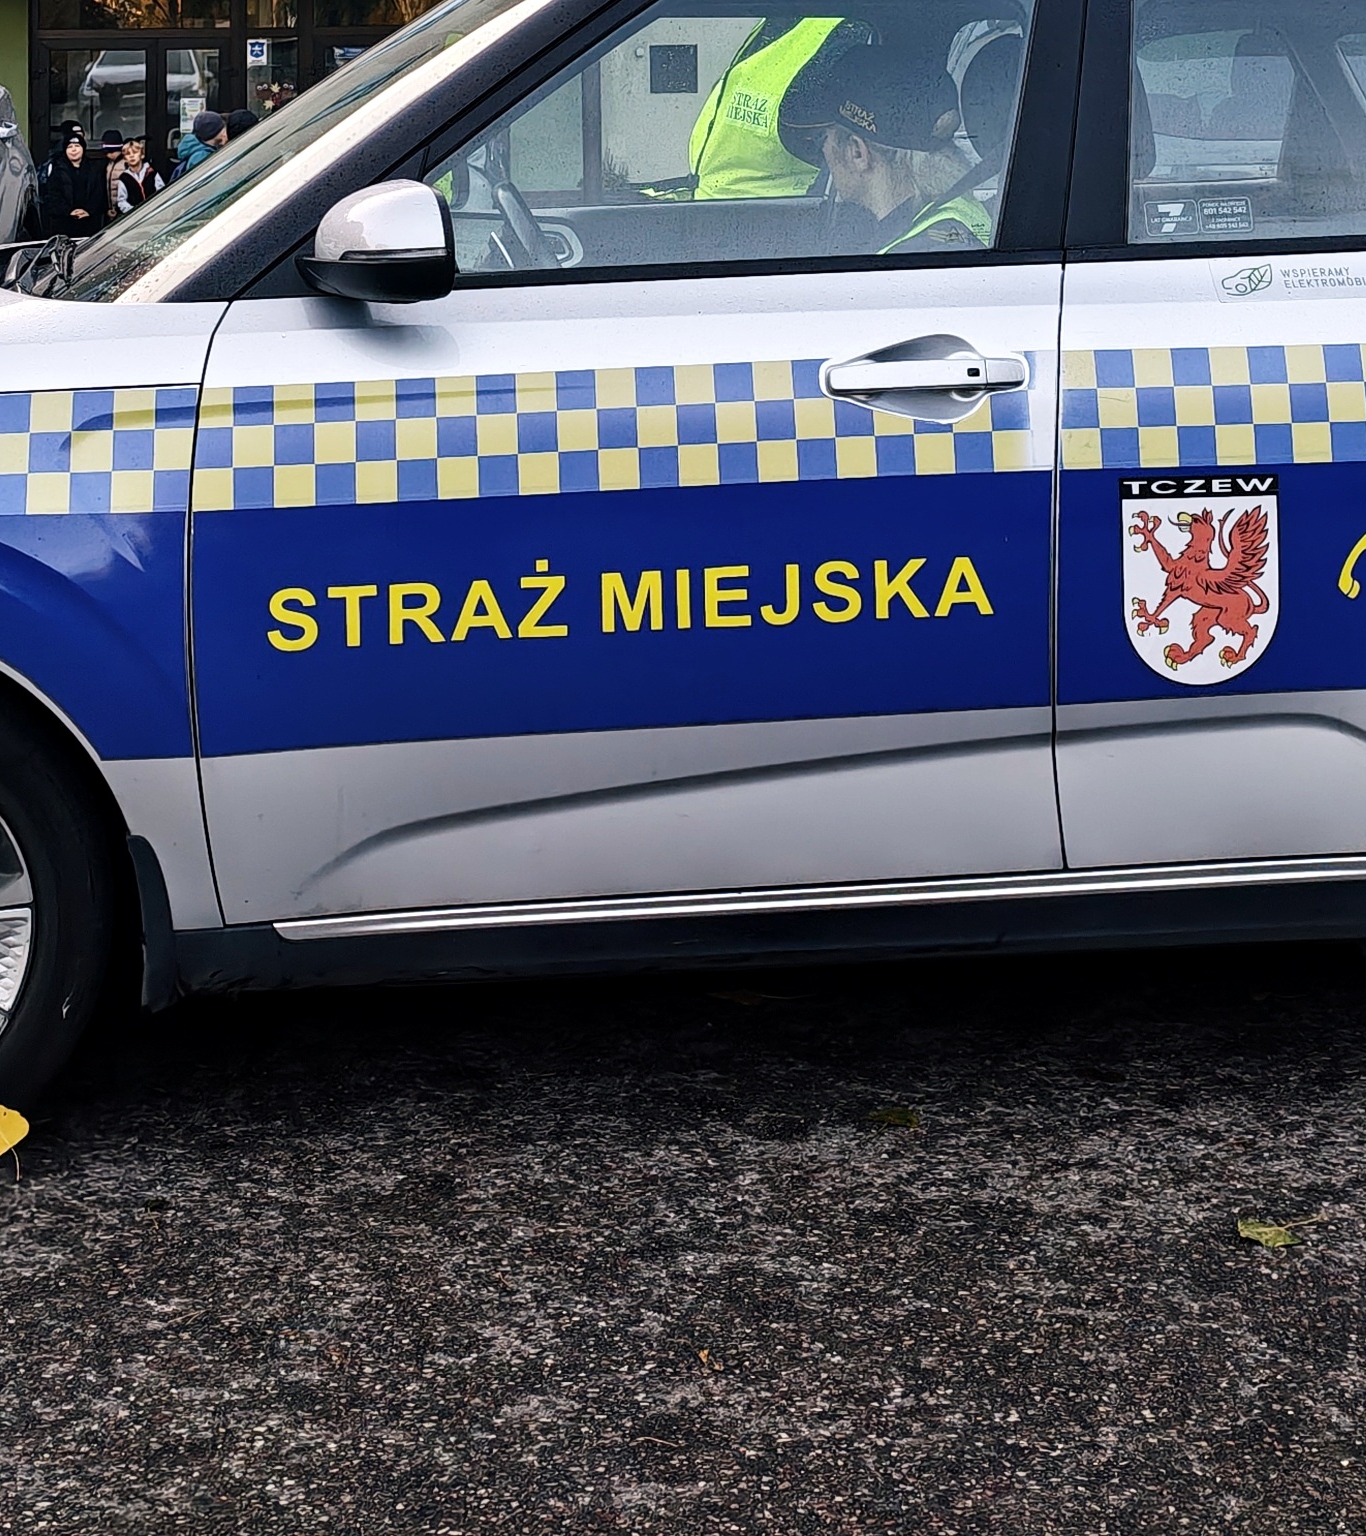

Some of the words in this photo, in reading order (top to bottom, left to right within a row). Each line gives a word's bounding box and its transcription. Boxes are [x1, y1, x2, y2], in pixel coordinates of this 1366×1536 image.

[726, 105, 768, 128] IEJSKA
[1280, 267, 1350, 278] WSPIERAMY
[1123, 477, 1274, 495] TCZEW
[266, 559, 568, 652] STRAŻ
[601, 556, 994, 632] MIEJSKA
